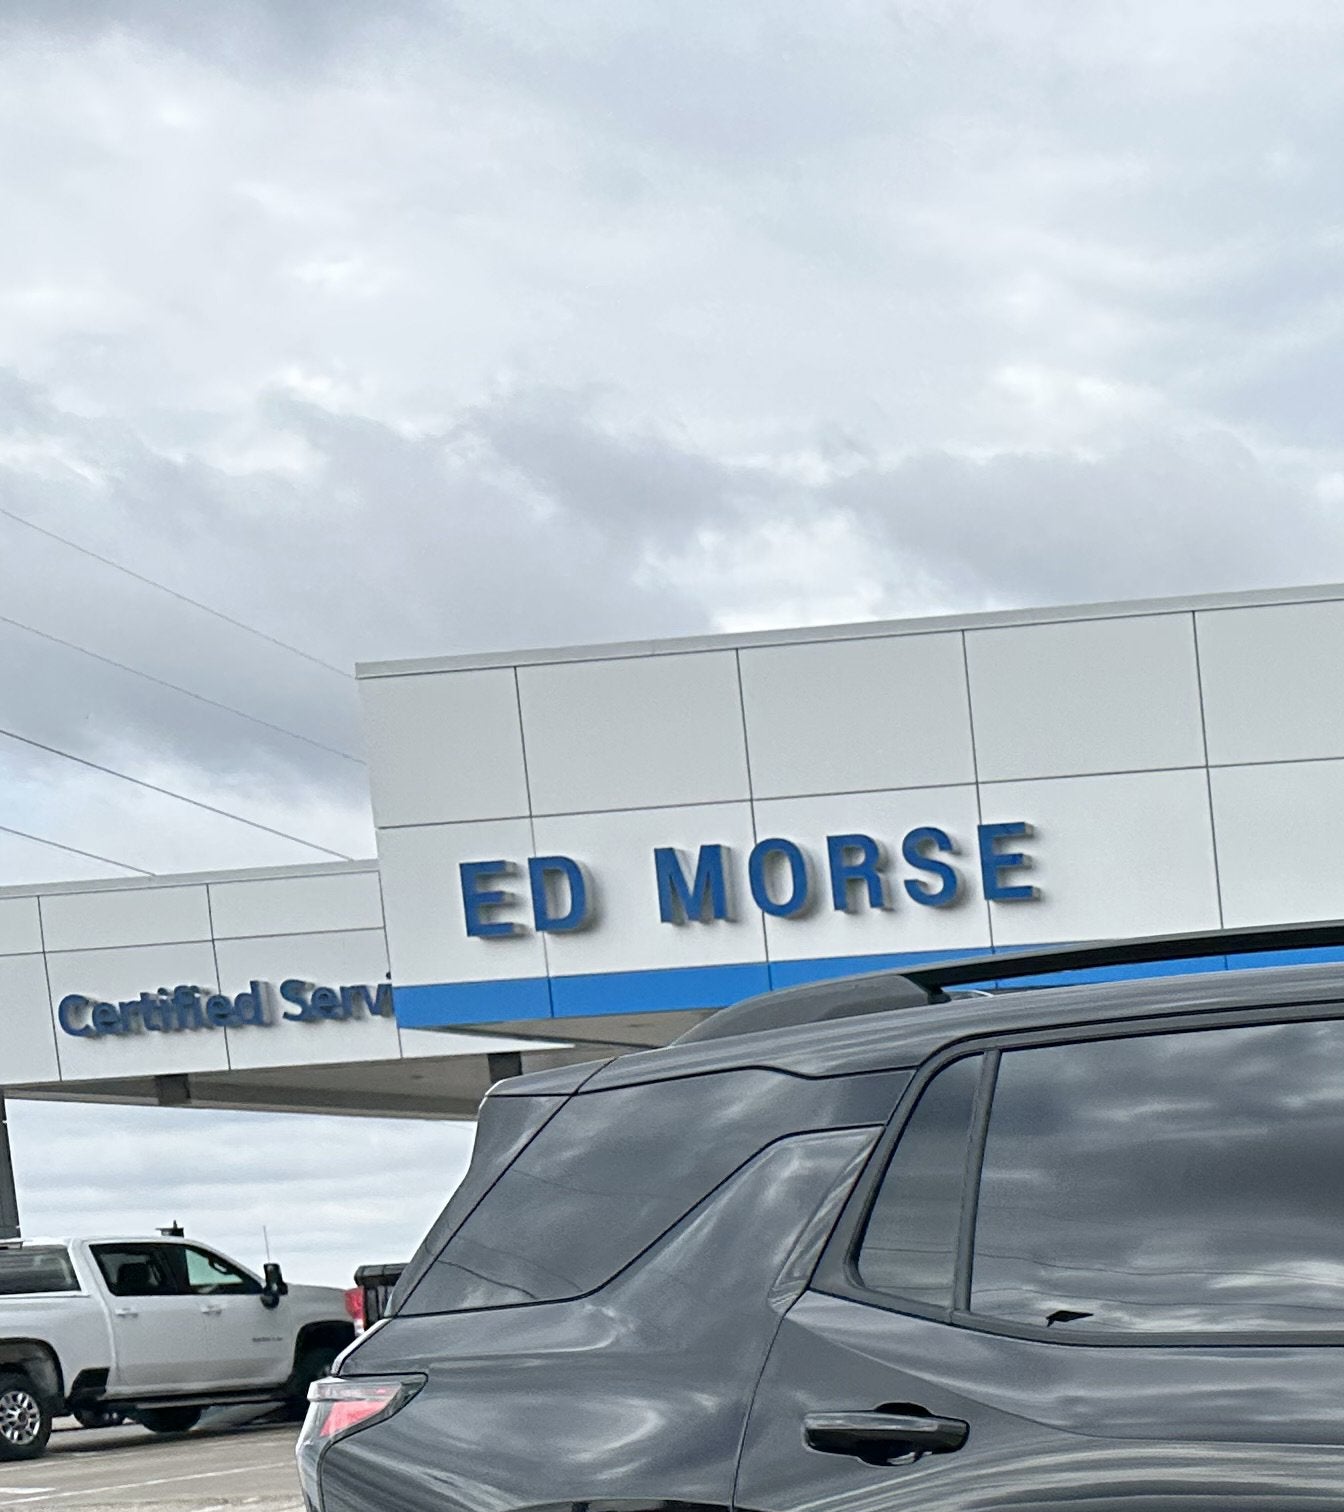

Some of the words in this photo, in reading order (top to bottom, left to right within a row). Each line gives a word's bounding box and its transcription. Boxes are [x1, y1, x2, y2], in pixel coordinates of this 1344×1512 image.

[459, 854, 593, 938] ED
[654, 821, 1040, 925] MORSE
[58, 980, 271, 1037] Certified
[280, 971, 394, 1022] Serv
